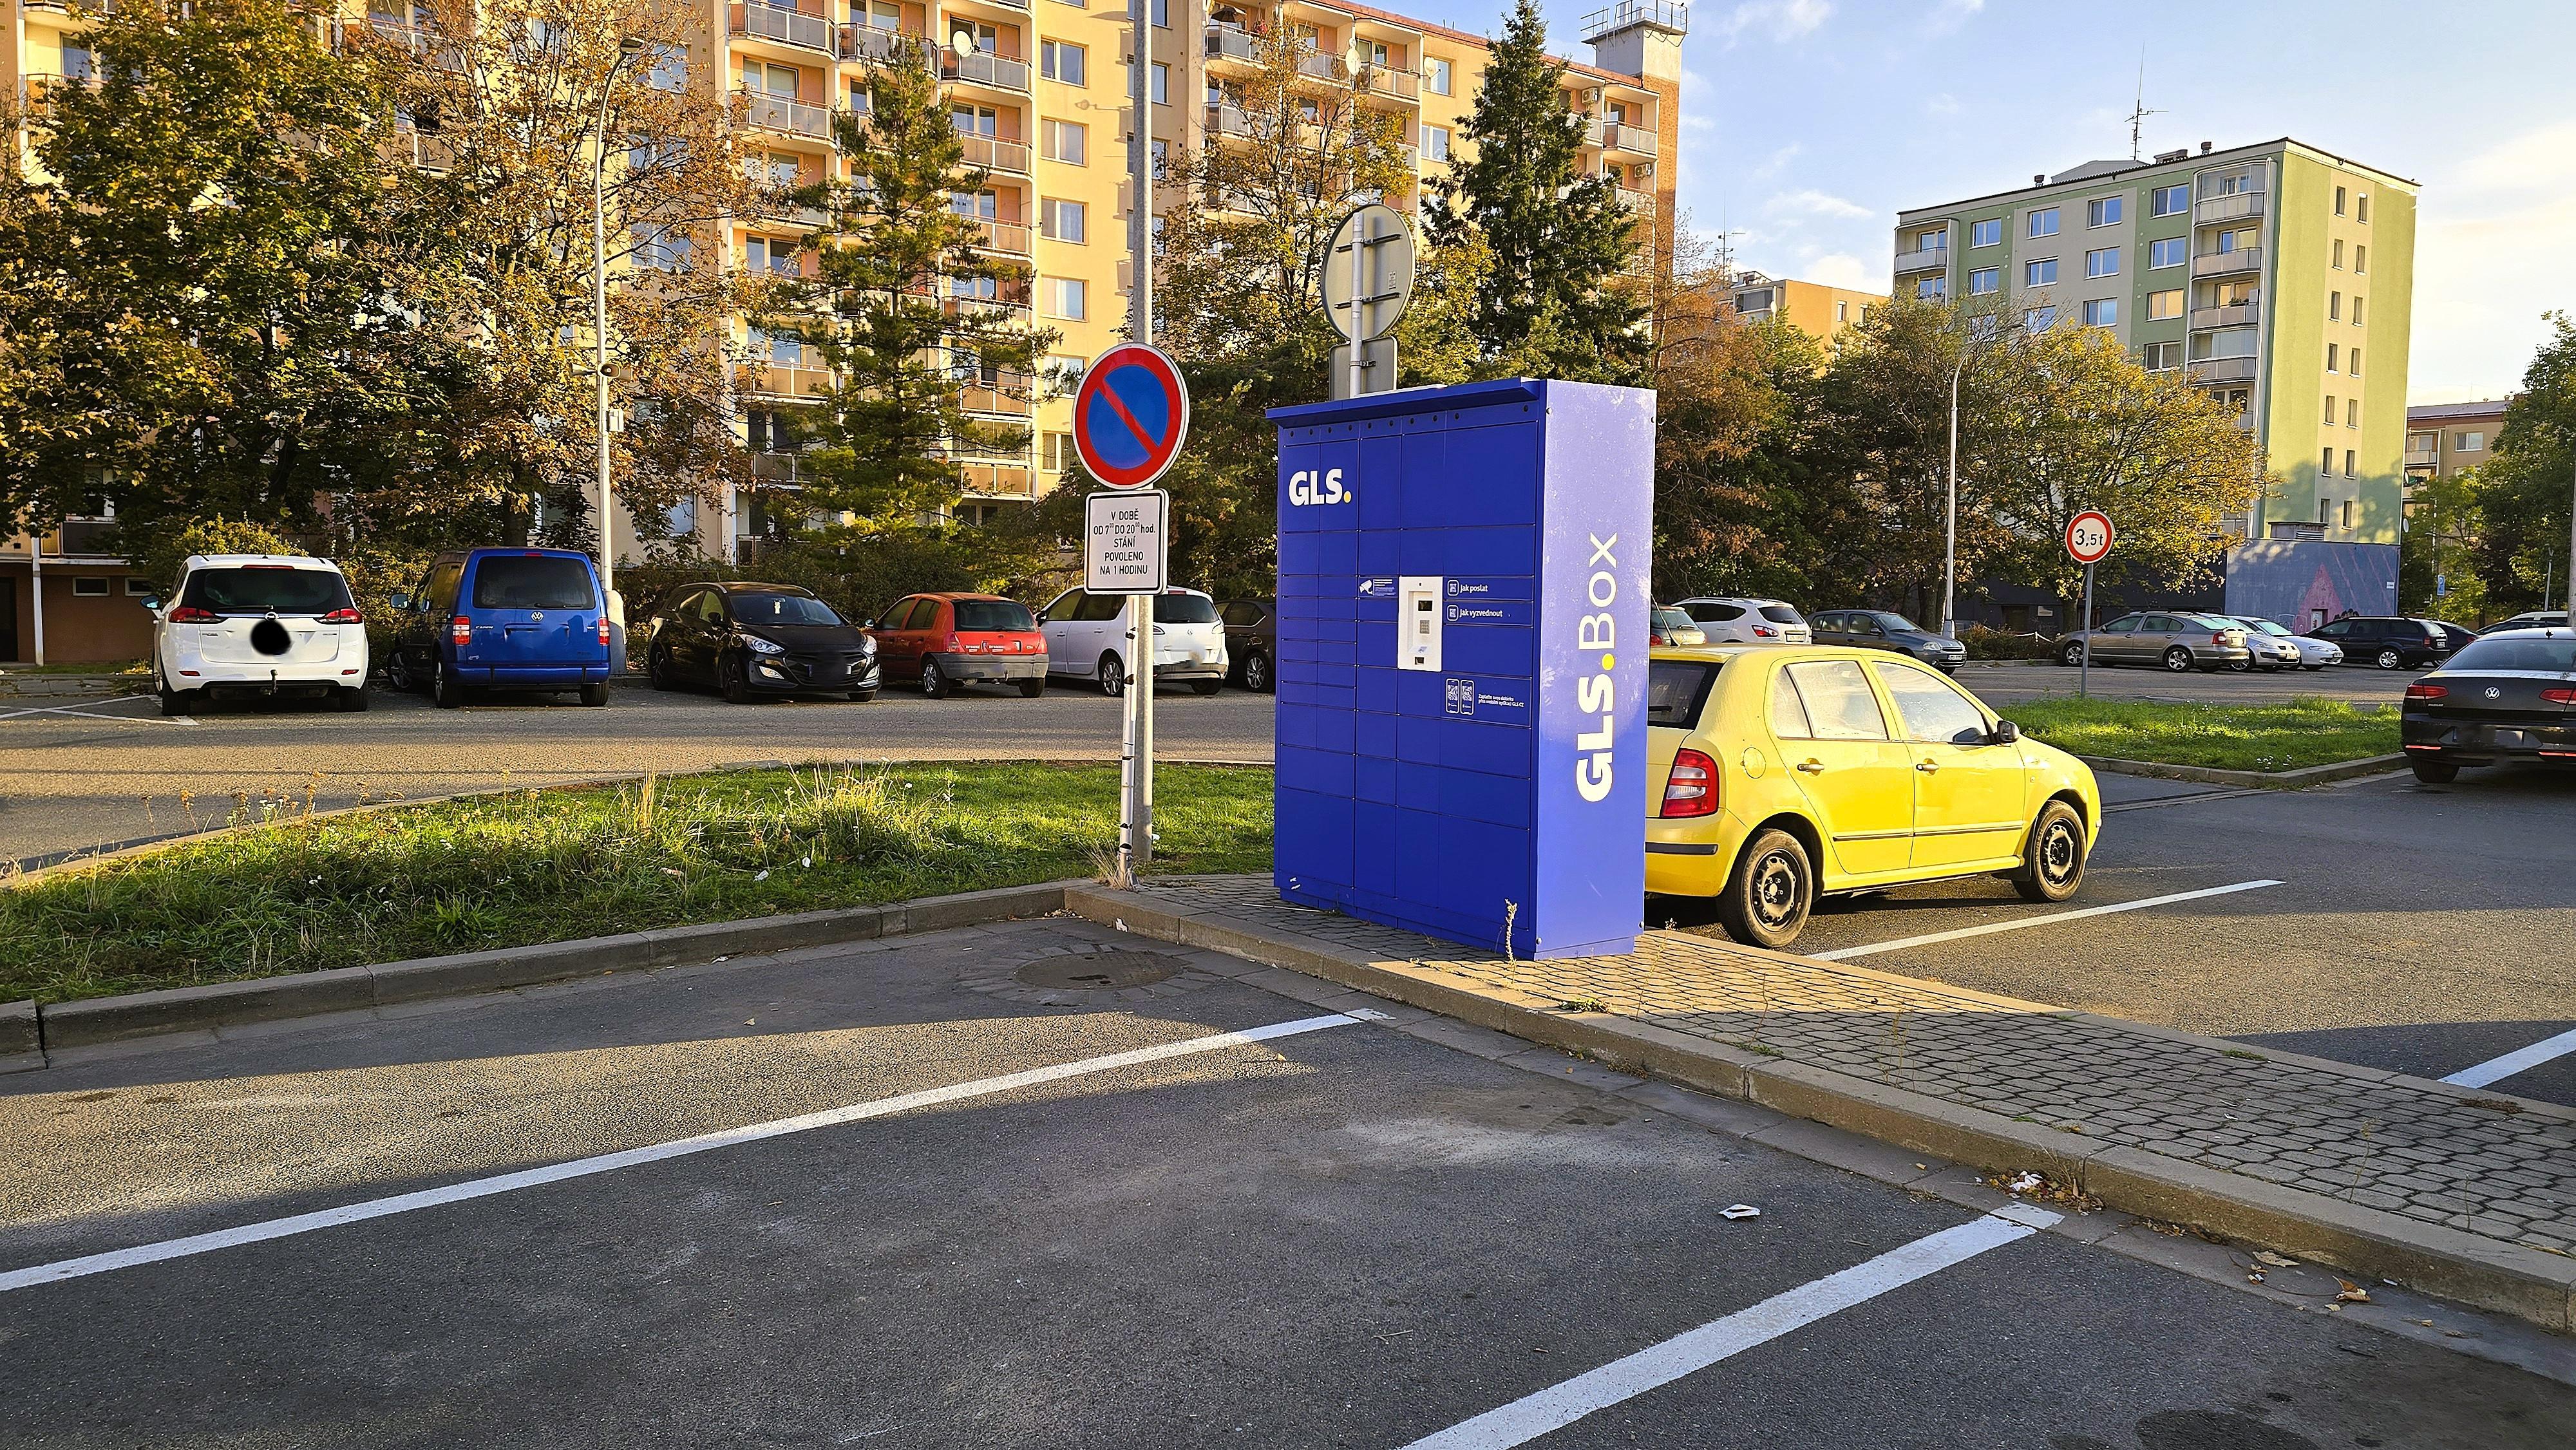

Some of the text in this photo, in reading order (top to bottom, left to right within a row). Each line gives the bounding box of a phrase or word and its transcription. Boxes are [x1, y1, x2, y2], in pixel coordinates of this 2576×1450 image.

[1289, 468, 1352, 506] GLS.
[1111, 508, 1139, 521] V DOBĚ
[1094, 525, 1103, 535] OD
[1115, 525, 1125, 534] DO
[1141, 523, 1155, 533] hod.
[1113, 536, 1136, 548] STÁNÍ
[1104, 551, 1144, 561] POVOLENO
[1100, 565, 1148, 575] NA 1 HODINU
[1460, 584, 1488, 593] Jak poslat
[1459, 608, 1503, 618] Jak vyzvednout
